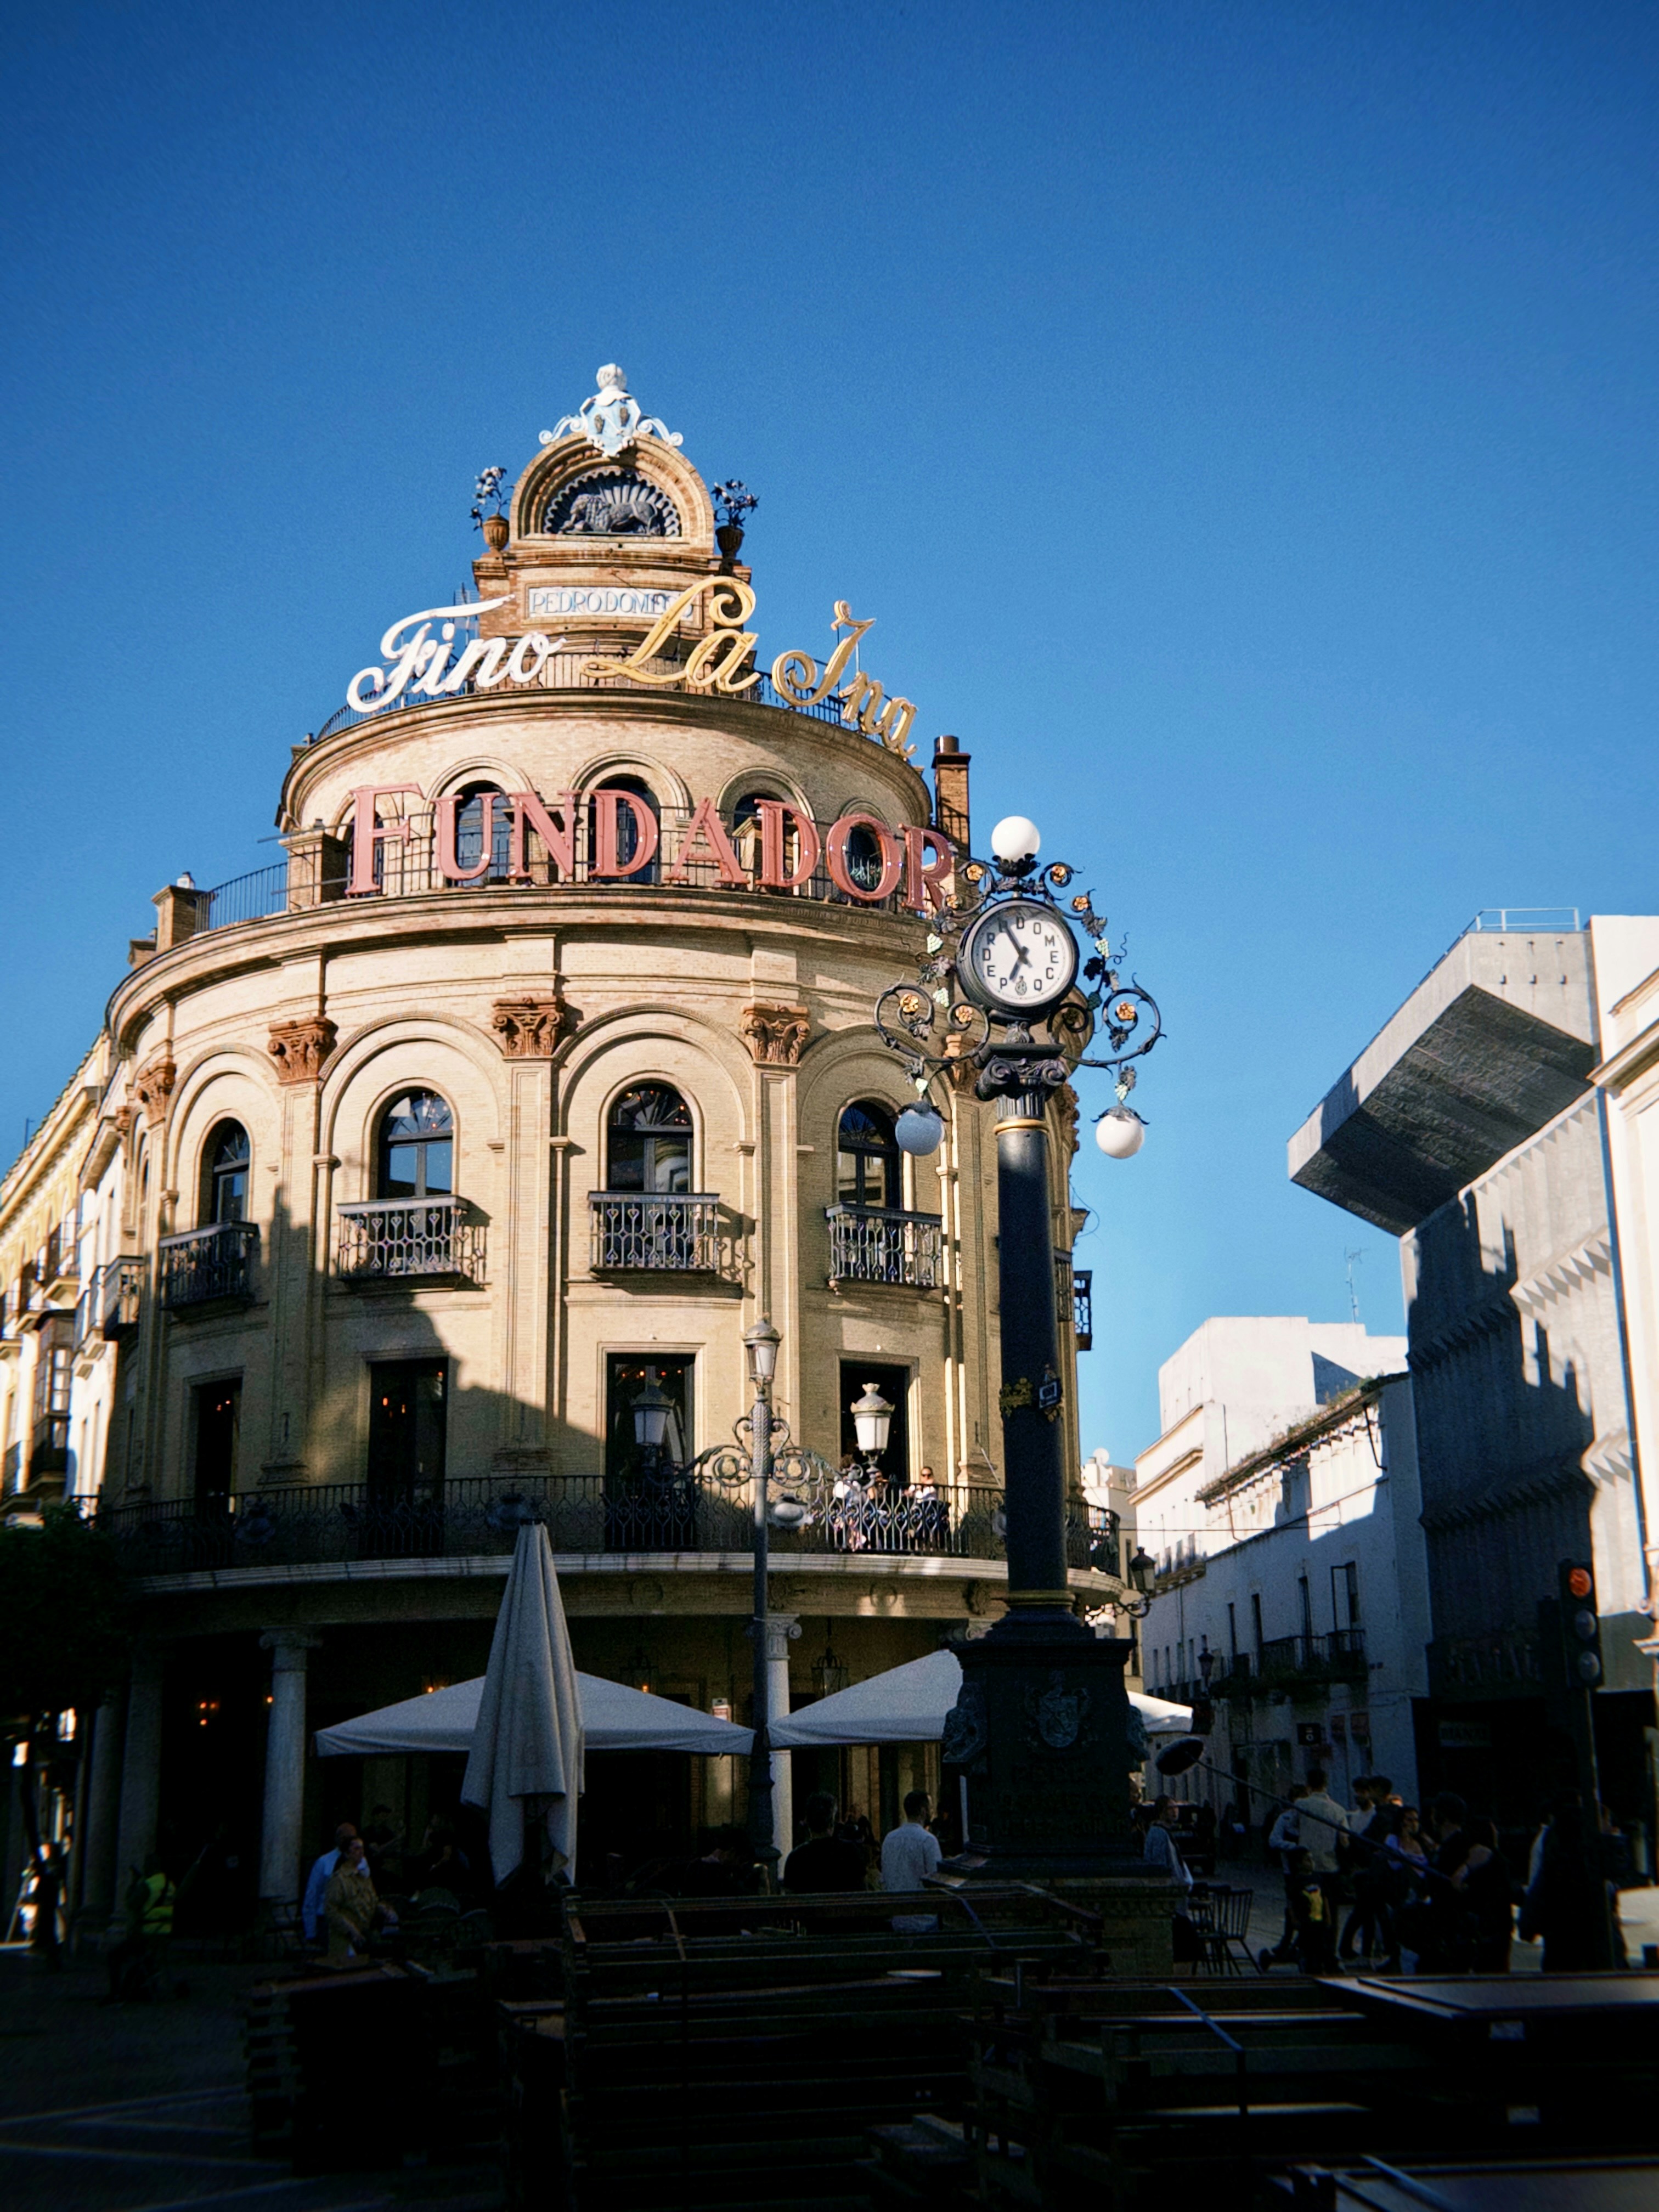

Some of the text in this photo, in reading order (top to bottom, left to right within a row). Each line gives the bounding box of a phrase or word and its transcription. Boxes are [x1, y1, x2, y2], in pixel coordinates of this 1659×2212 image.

[347, 576, 918, 757] Fino La Ina
[530, 591, 602, 614] PEDRO
[345, 783, 952, 912] FUNDADOR
